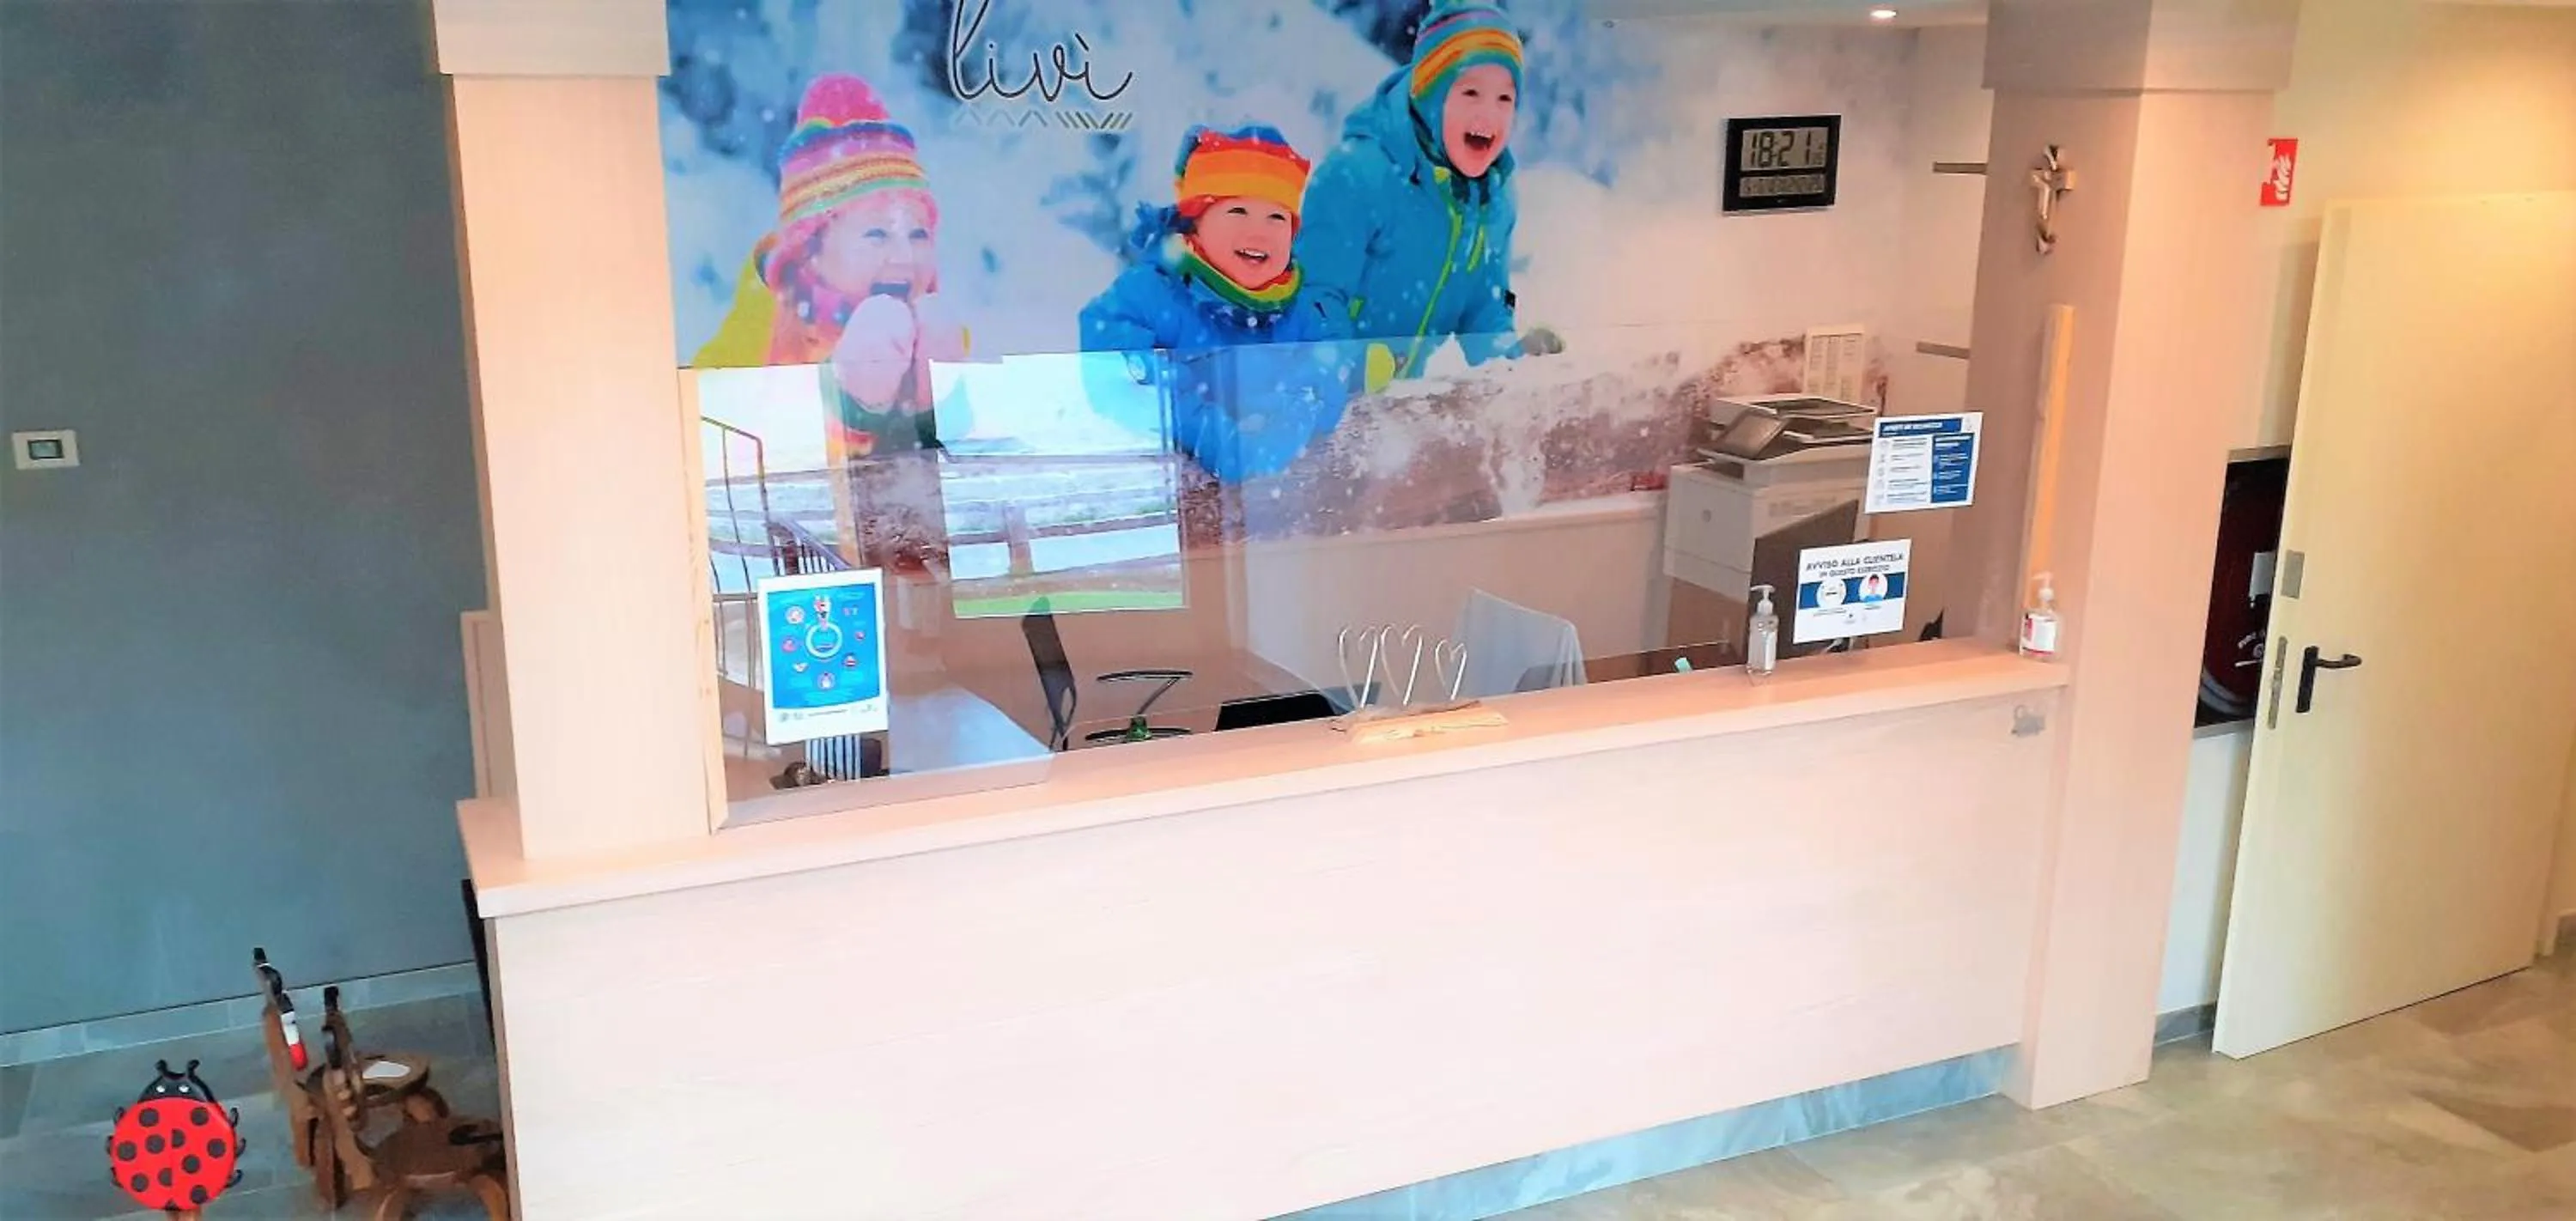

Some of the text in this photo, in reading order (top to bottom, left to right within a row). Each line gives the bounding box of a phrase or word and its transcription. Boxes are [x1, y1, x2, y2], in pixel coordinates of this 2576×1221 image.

[1807, 553, 1904, 571] AVVISO ALLA CLIENTELA
